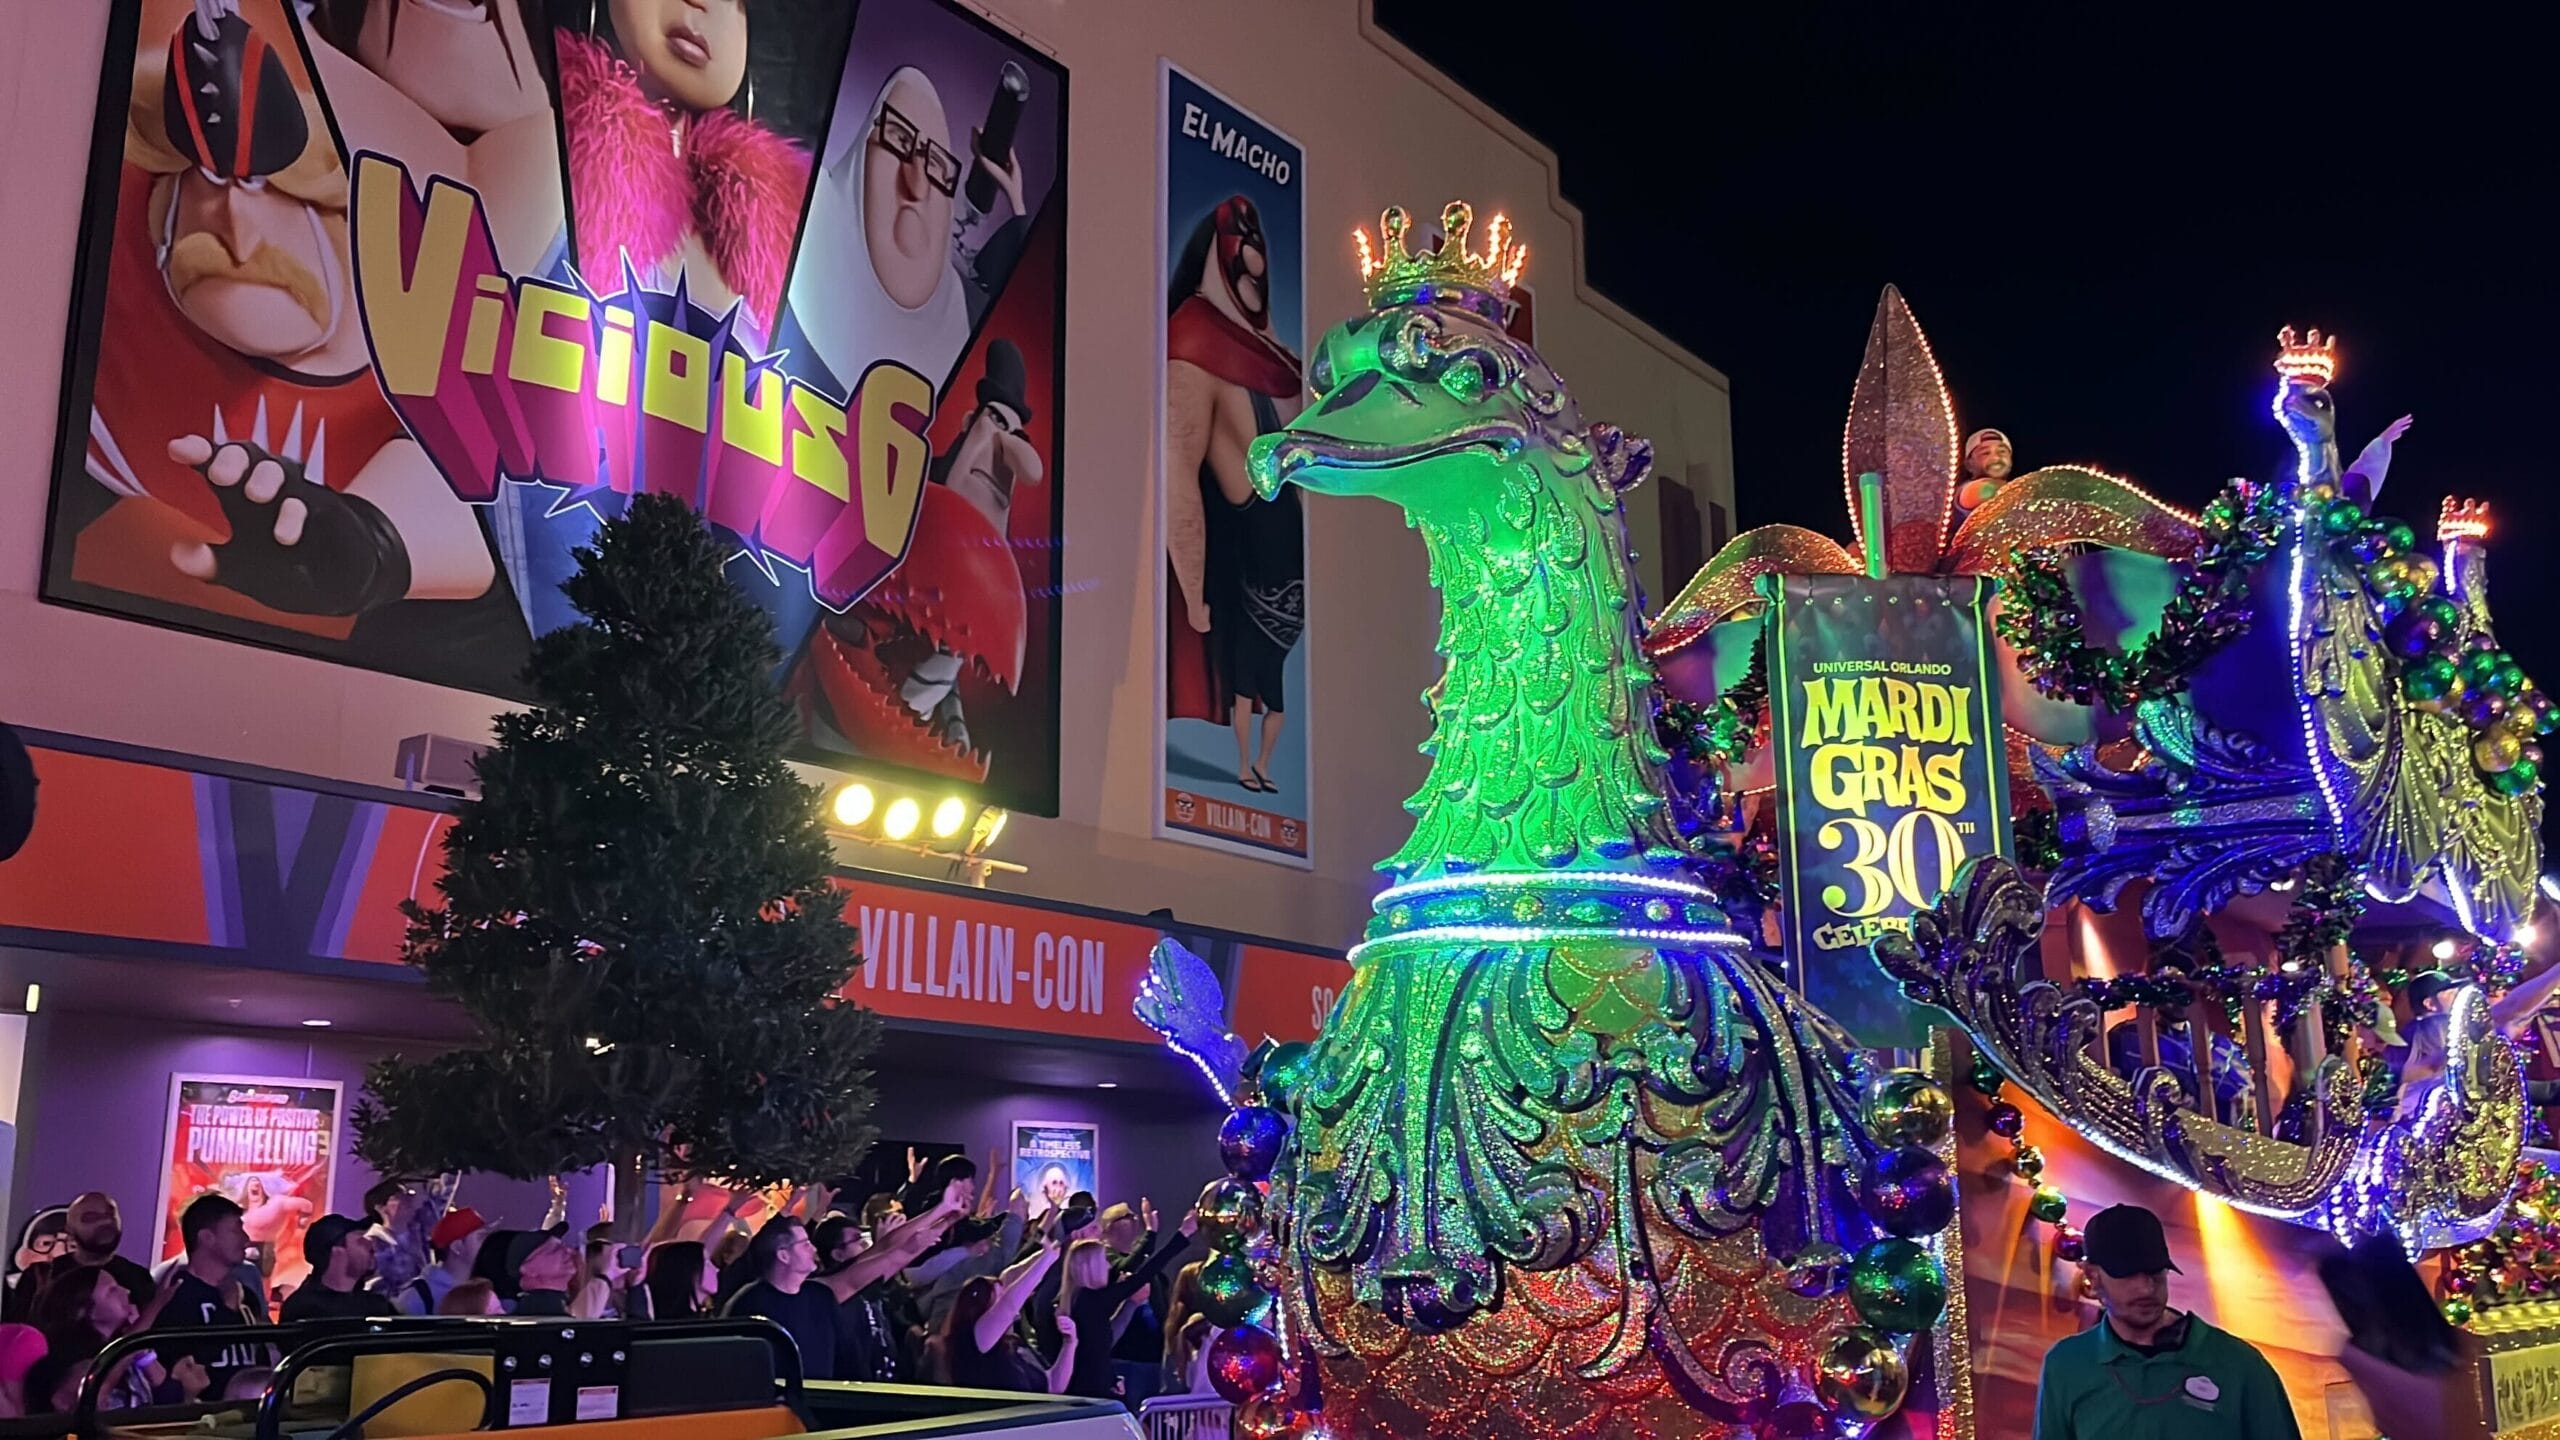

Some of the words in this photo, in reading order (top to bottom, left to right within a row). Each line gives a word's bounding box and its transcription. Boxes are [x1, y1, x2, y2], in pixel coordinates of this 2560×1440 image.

[1182, 102, 1209, 139] EL
[1211, 121, 1290, 185] MACHO
[853, 361, 930, 565] 6
[1813, 660, 1889, 674] UNIVERSAL
[1891, 661, 1952, 675] ORLANDO
[1801, 676, 1974, 749] MARDI
[1810, 741, 1967, 817] GRAS
[1206, 802, 1271, 839] VILLAIN-CON
[859, 905, 1105, 1016] VILLAIN-CON
[187, 1126, 319, 1165] PUMMELLING
[190, 1104, 211, 1125] THE
[213, 1105, 253, 1127] POWER
[255, 1106, 269, 1128] OF
[270, 1107, 320, 1129] POSITIVE
